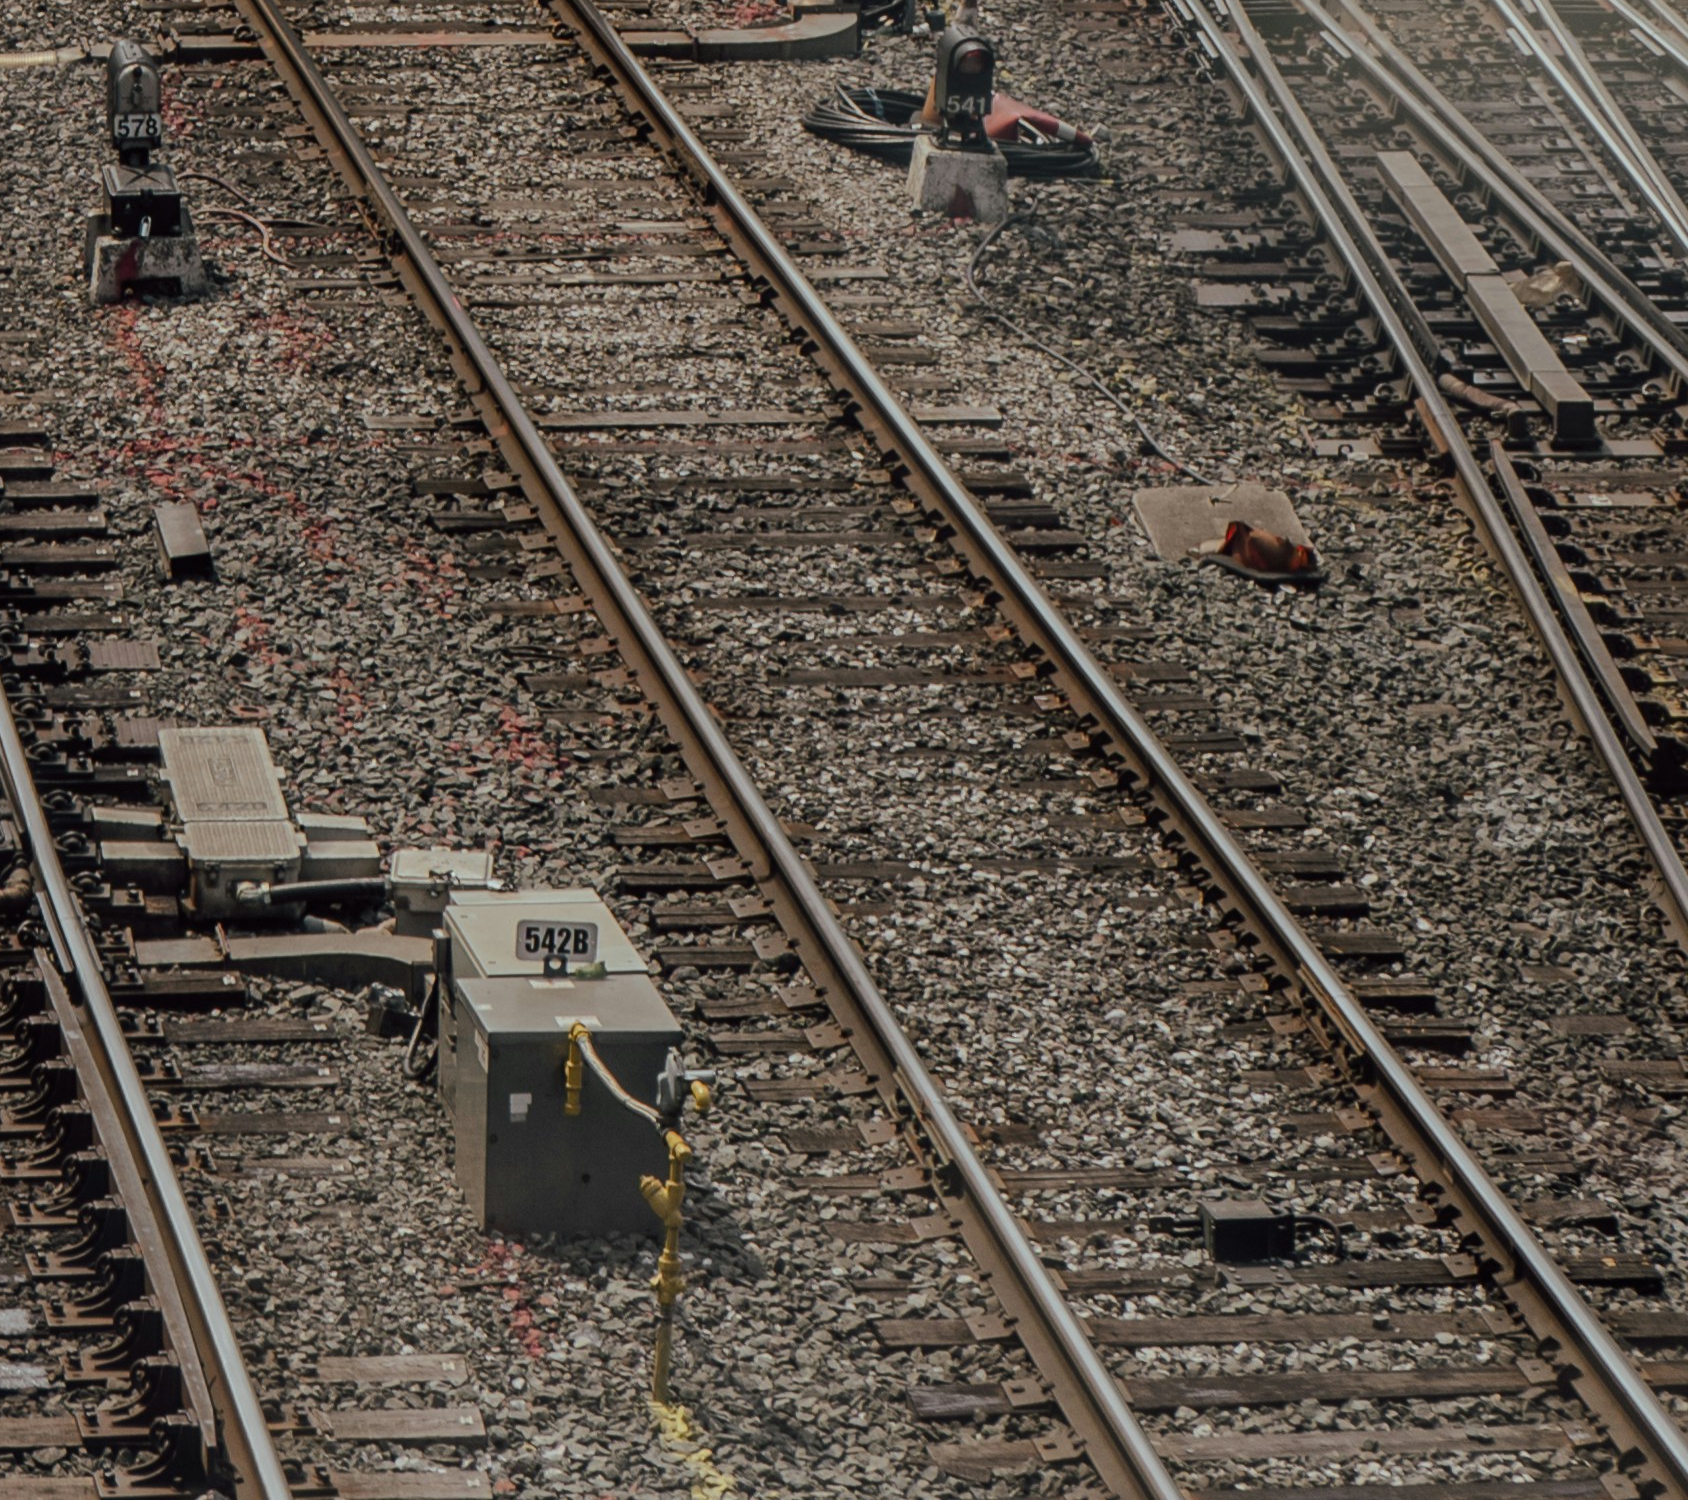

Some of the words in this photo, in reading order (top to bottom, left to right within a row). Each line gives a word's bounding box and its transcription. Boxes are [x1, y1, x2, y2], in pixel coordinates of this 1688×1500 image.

[946, 96, 987, 113] 541
[116, 117, 160, 137] 578
[524, 928, 590, 957] 542B
